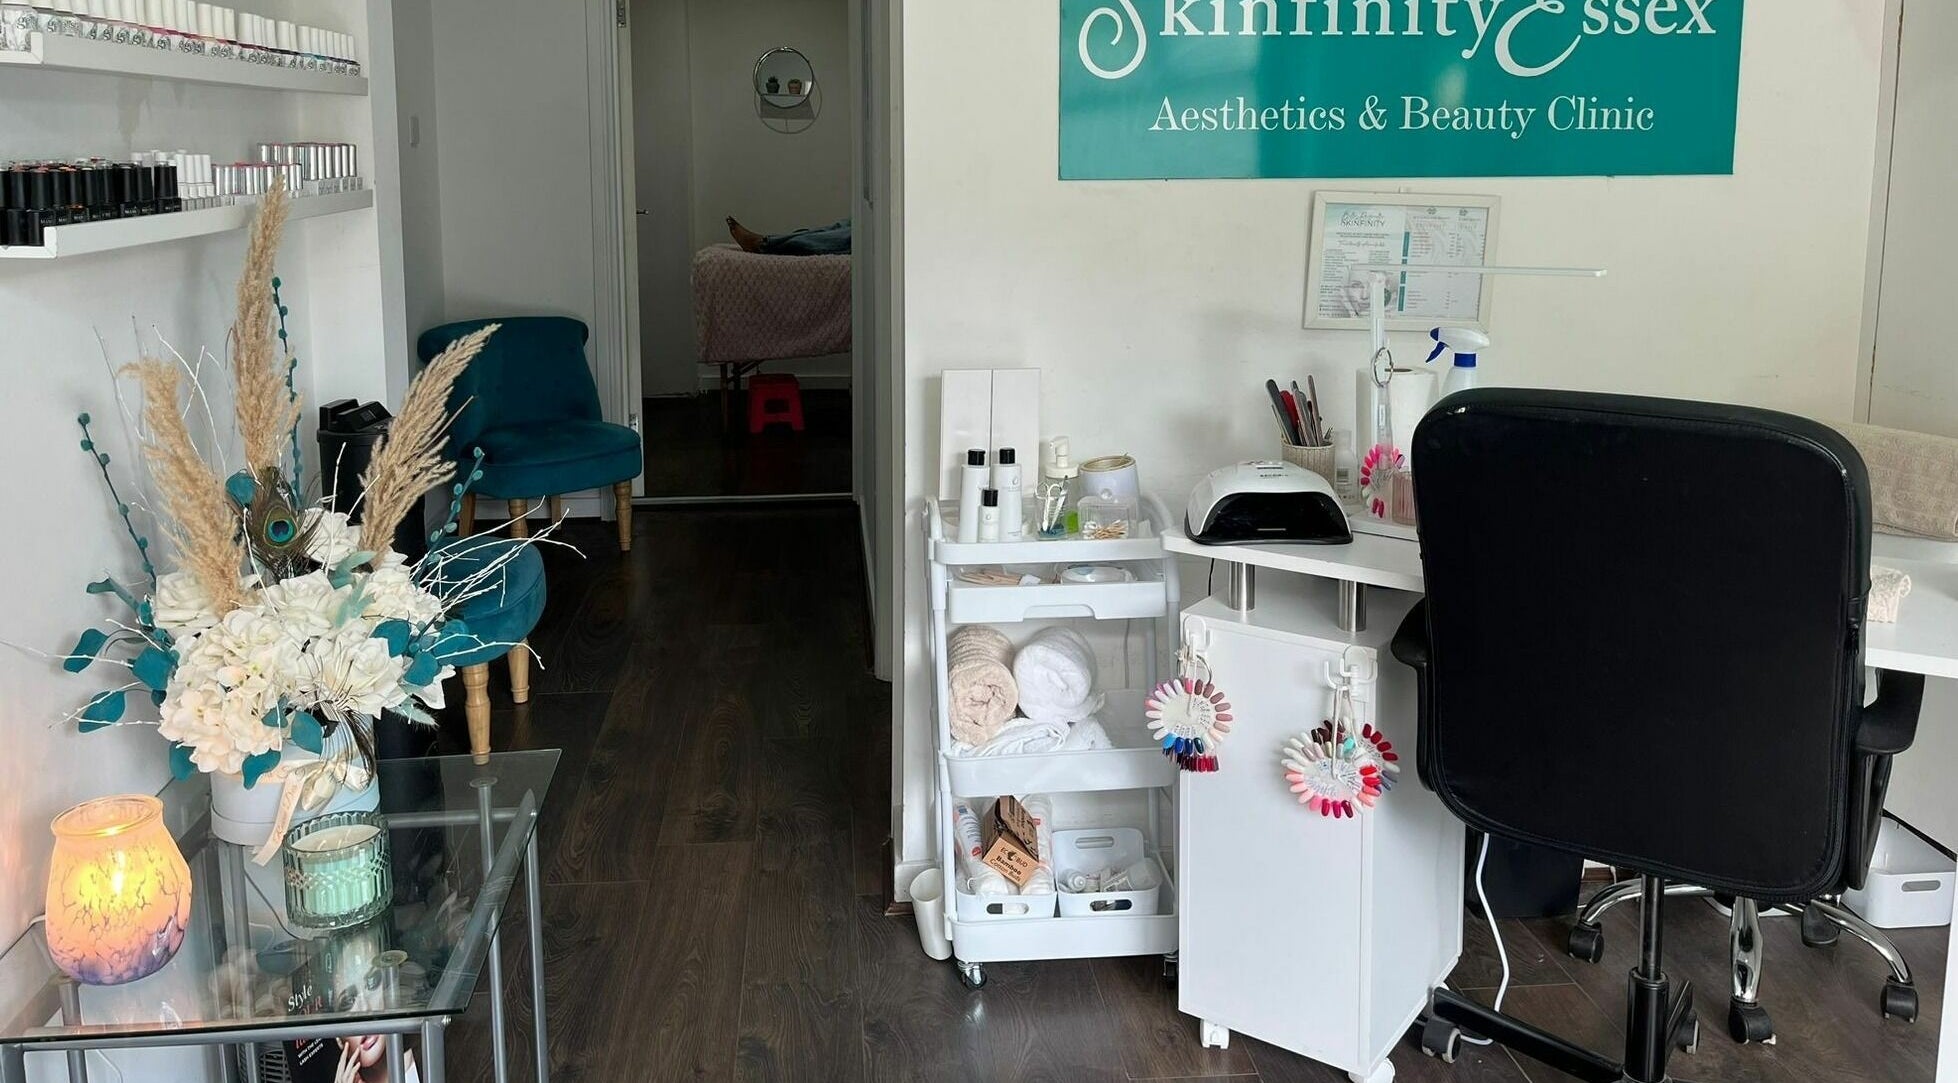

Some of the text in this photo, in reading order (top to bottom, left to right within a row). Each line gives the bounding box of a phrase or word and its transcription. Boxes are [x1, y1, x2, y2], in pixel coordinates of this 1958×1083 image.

[1148, 95, 1654, 139] Aesthetics & Beauty Clinic
[989, 858, 1009, 873] Cotton
[996, 855, 1022, 876] Bamboo
[288, 984, 313, 1012] Style
